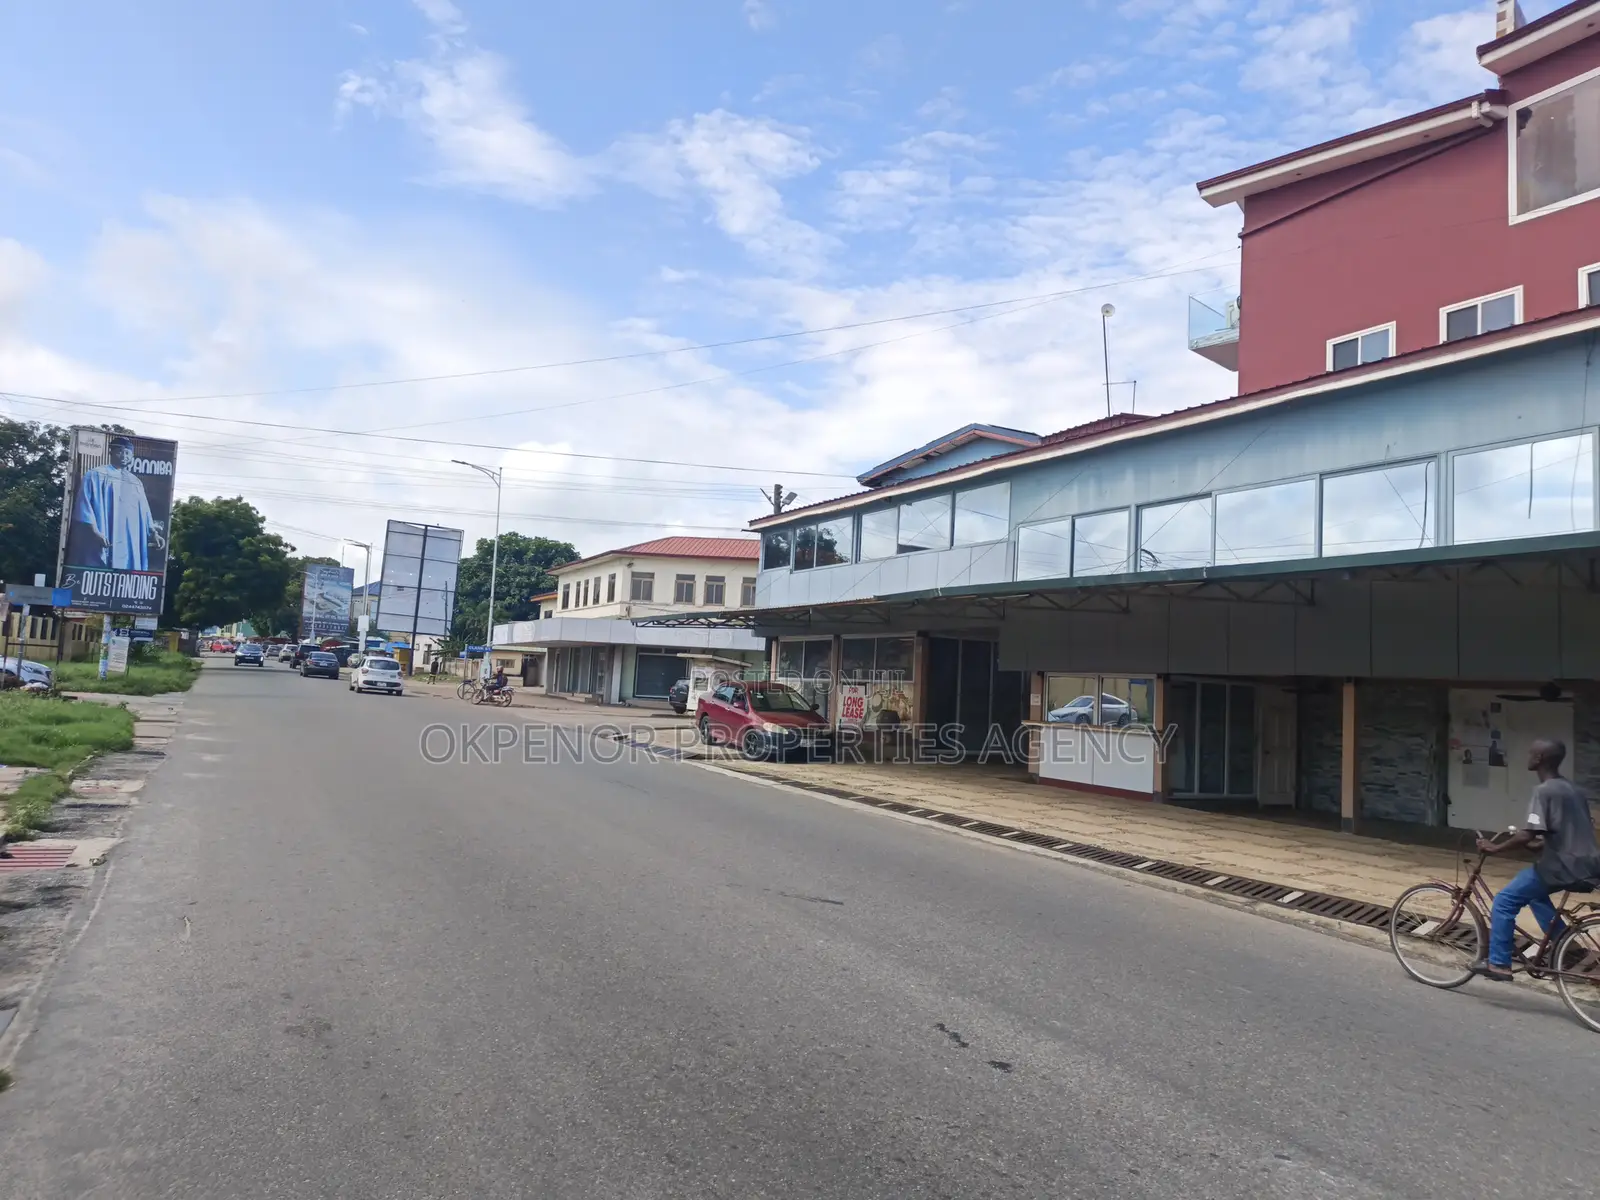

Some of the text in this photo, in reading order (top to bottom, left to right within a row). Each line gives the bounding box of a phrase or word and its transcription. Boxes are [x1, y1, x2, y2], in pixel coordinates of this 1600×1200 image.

[81, 570, 158, 600] OUTSTANDING
[848, 686, 859, 694] FOR
[843, 696, 864, 708] LONG
[841, 707, 864, 719] LEASE
